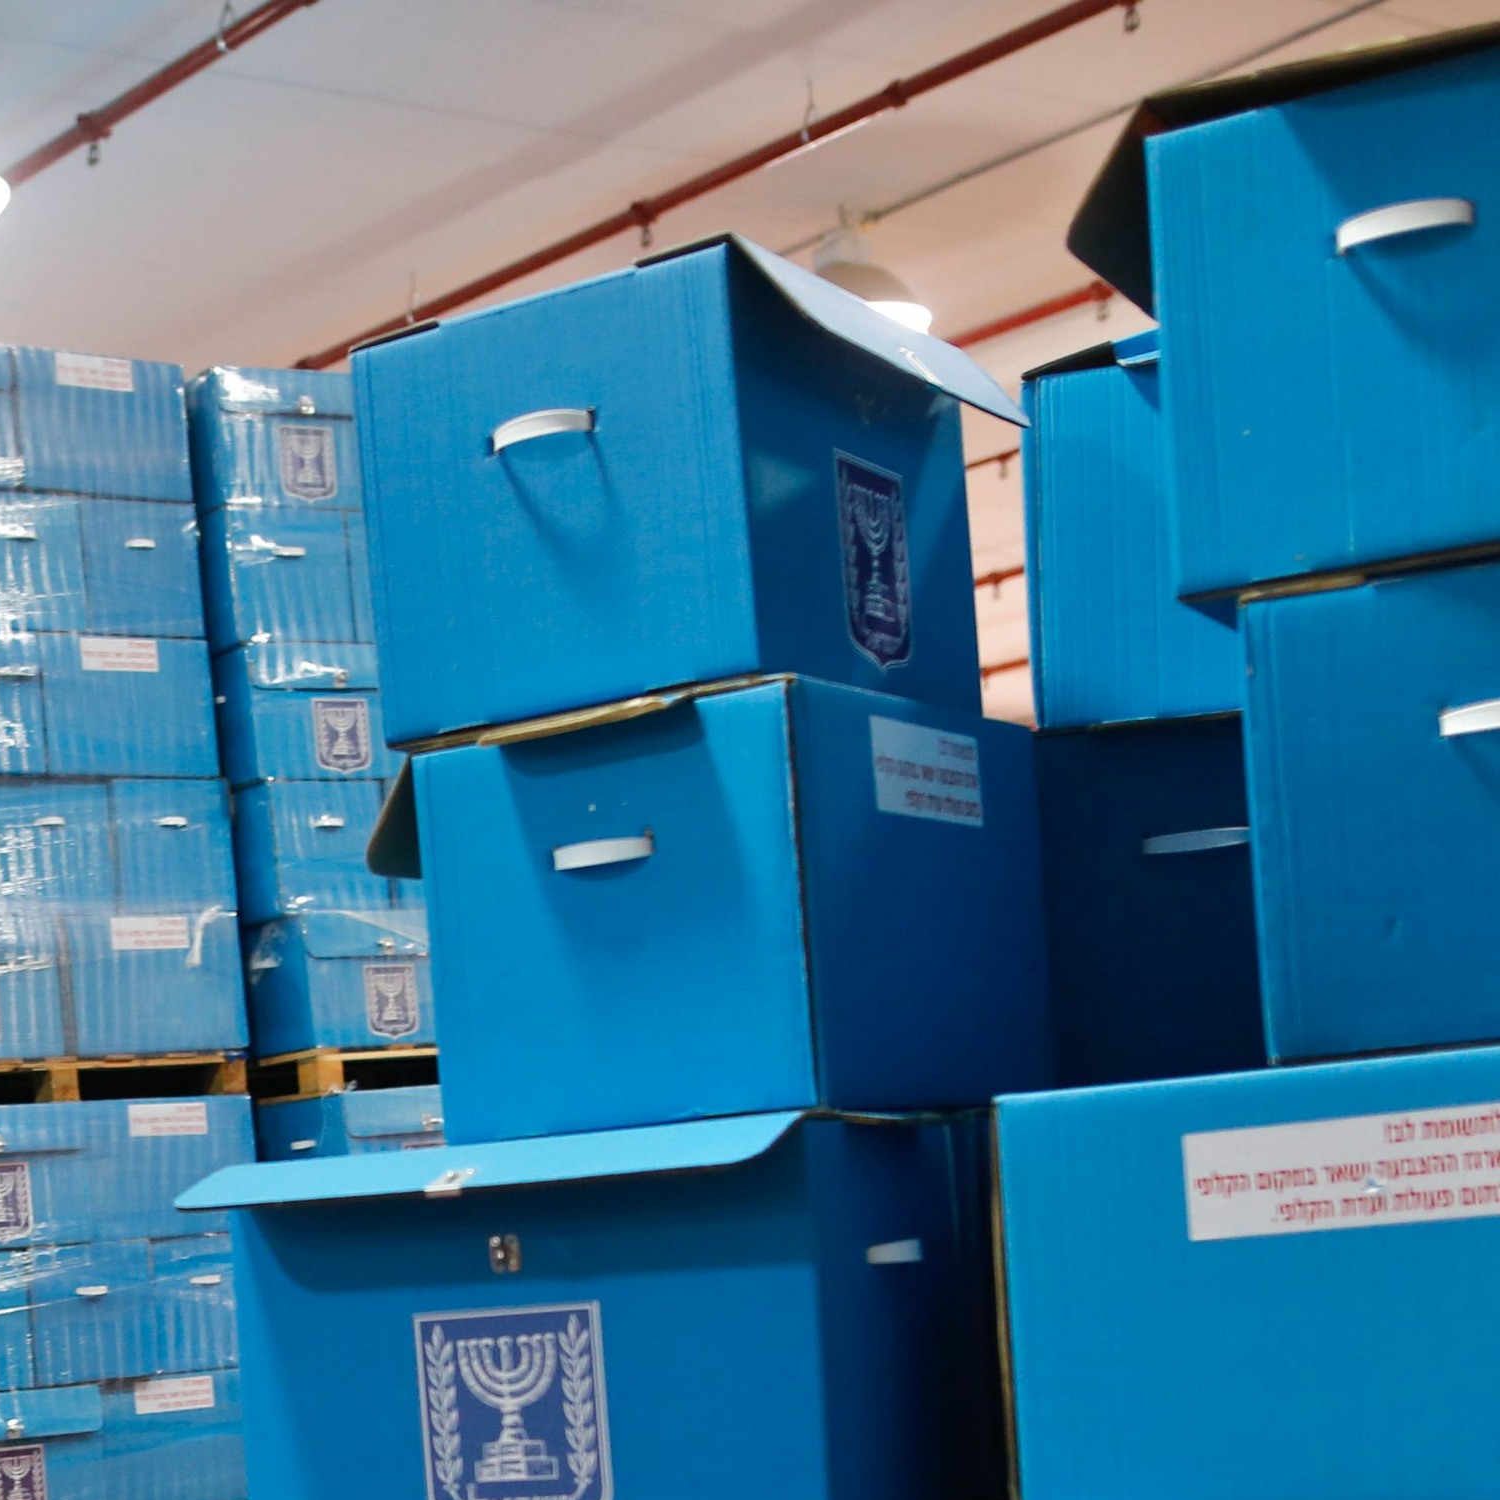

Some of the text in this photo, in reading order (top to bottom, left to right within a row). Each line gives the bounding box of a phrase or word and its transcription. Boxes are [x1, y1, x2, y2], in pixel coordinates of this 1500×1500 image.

[1376, 1154, 1458, 1180] ההצבעה
[1463, 1150, 1500, 1170] רגז
[1194, 1172, 1249, 1198] הקלפי
[1255, 1168, 1317, 1195] במקום
[1341, 1195, 1388, 1216] ועדת
[1393, 1187, 1454, 1212] פעולת
